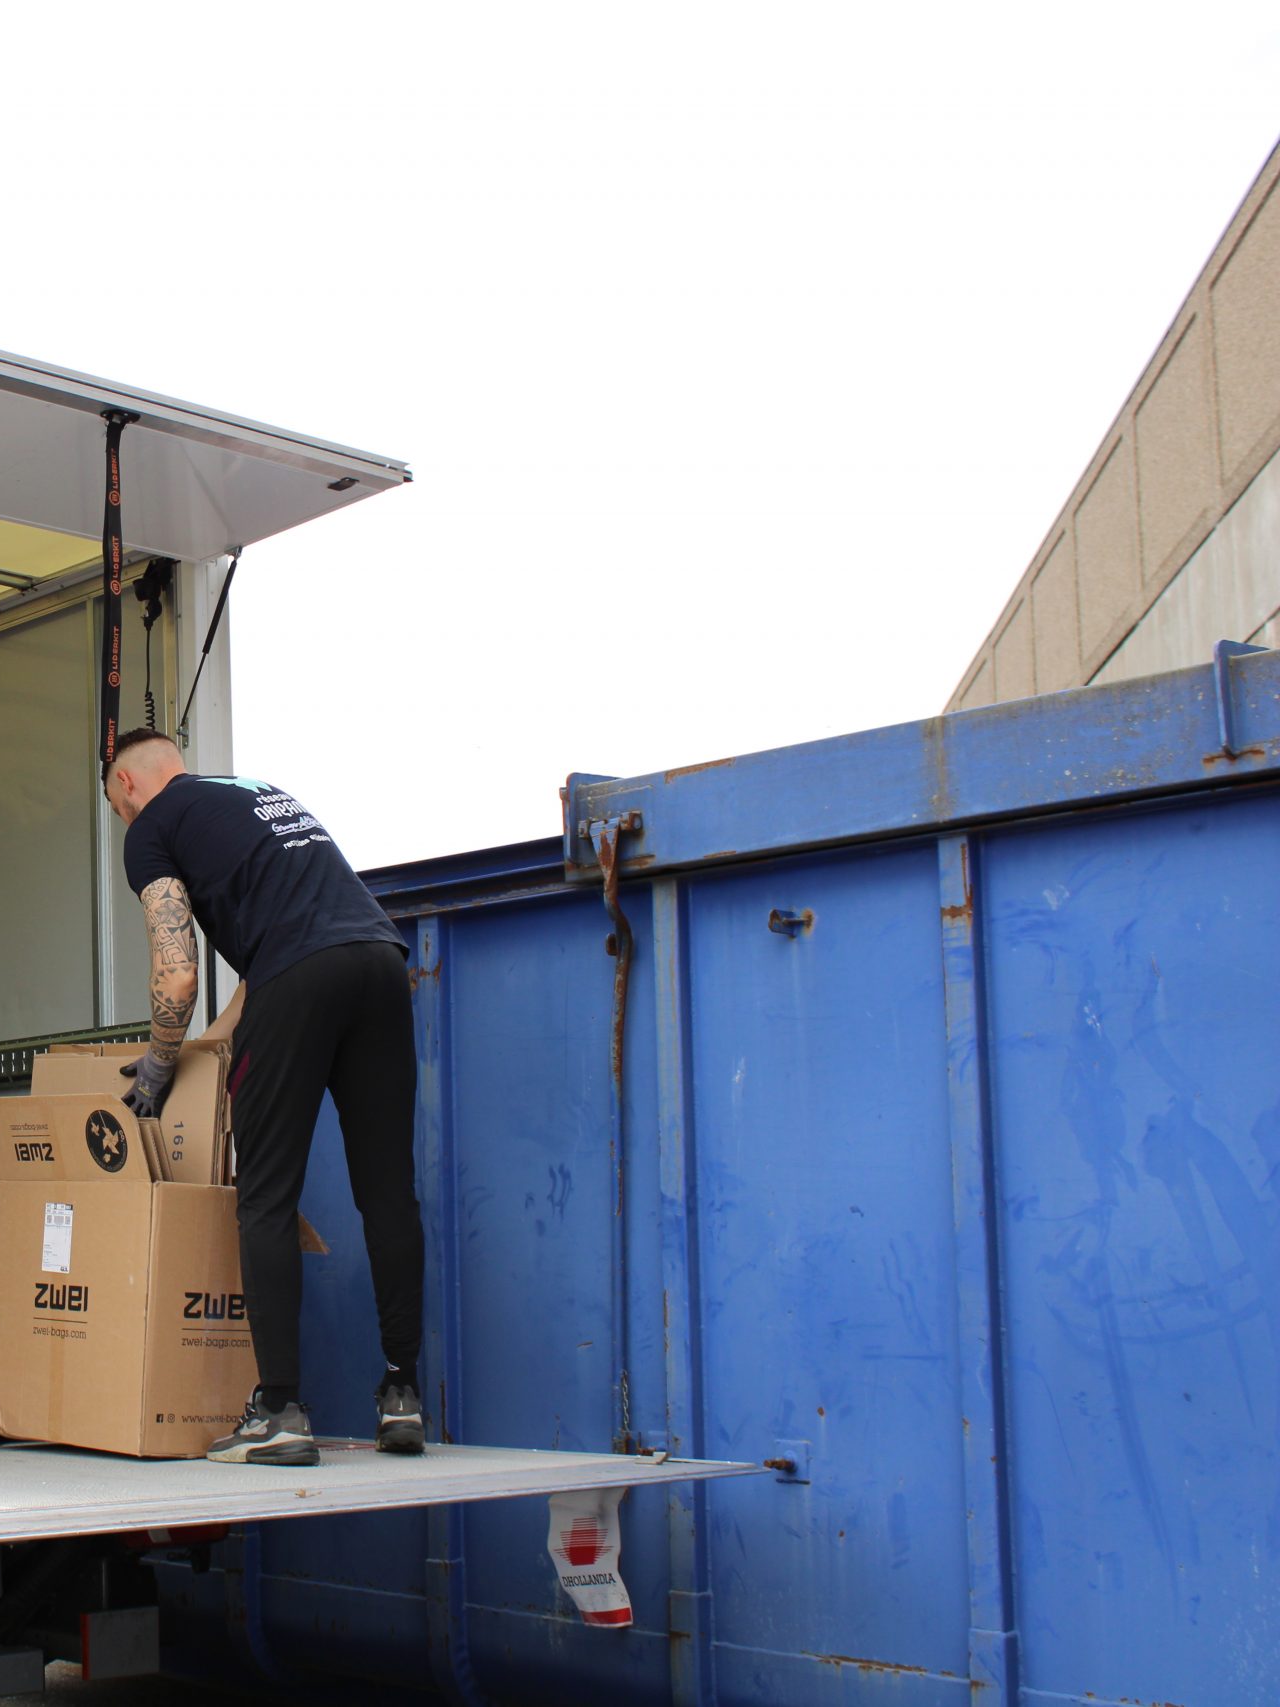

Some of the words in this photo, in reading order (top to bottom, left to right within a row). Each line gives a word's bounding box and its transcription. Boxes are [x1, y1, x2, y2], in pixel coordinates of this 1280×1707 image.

[112, 535, 120, 578] LIDERKIT
[106, 717, 116, 762] LIDERKIT
[561, 1572, 616, 1588] DHOLLANDIA
